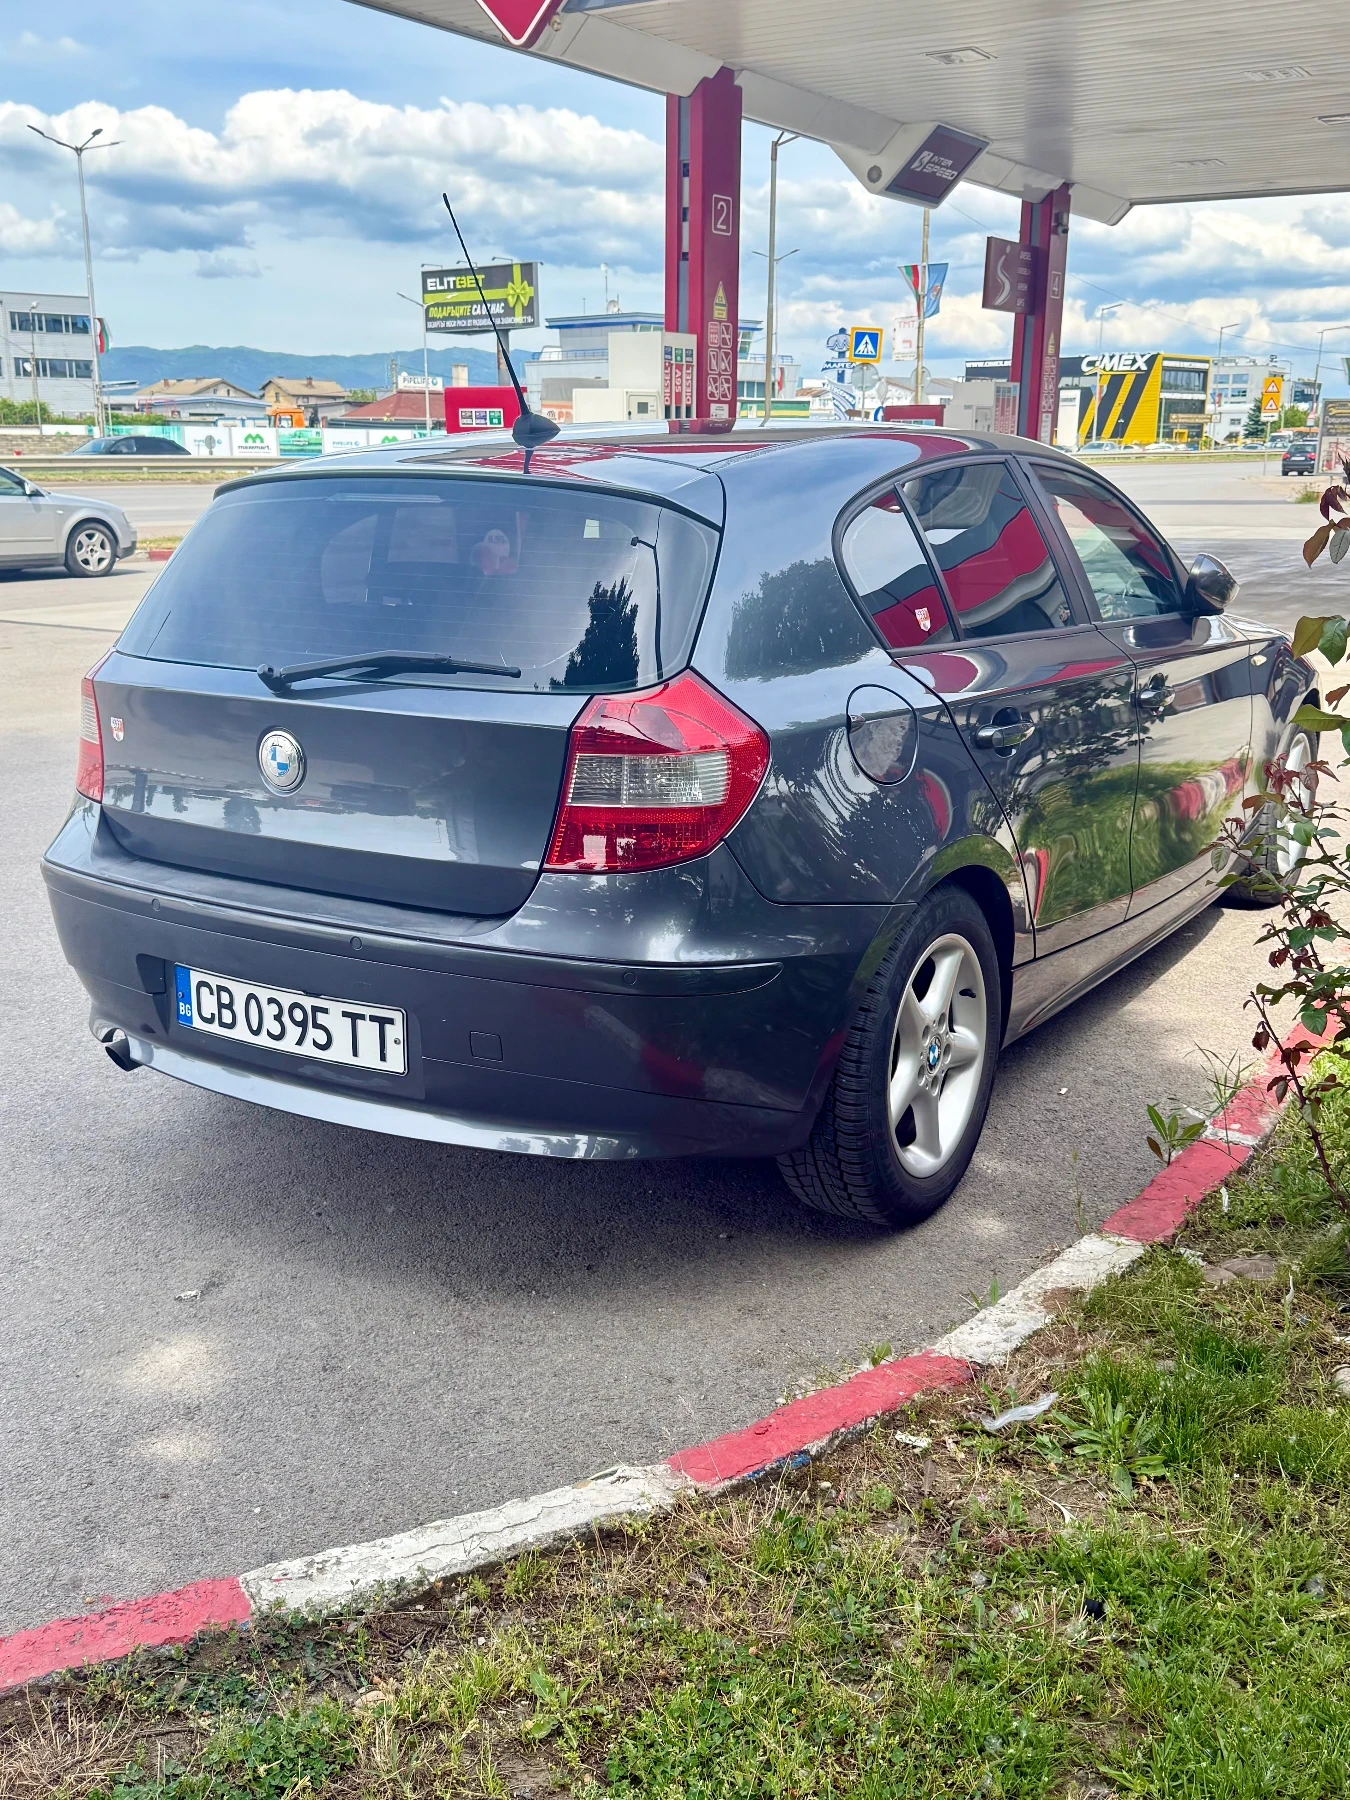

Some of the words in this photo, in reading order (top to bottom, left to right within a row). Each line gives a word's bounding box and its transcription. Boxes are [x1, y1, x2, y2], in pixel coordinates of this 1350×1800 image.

[931, 155, 953, 167] INTER
[923, 163, 958, 180] SPEED
[716, 201, 727, 230] 2
[426, 275, 485, 290] ELITBET
[1051, 277, 1059, 295] 4
[428, 305, 472, 319] ПОДАРЪЦИТЕ
[471, 304, 481, 316] СА
[490, 302, 505, 314] НАС
[1080, 352, 1154, 372] CIMEX
[179, 1001, 192, 1017] BG
[244, 992, 334, 1052] 0395
